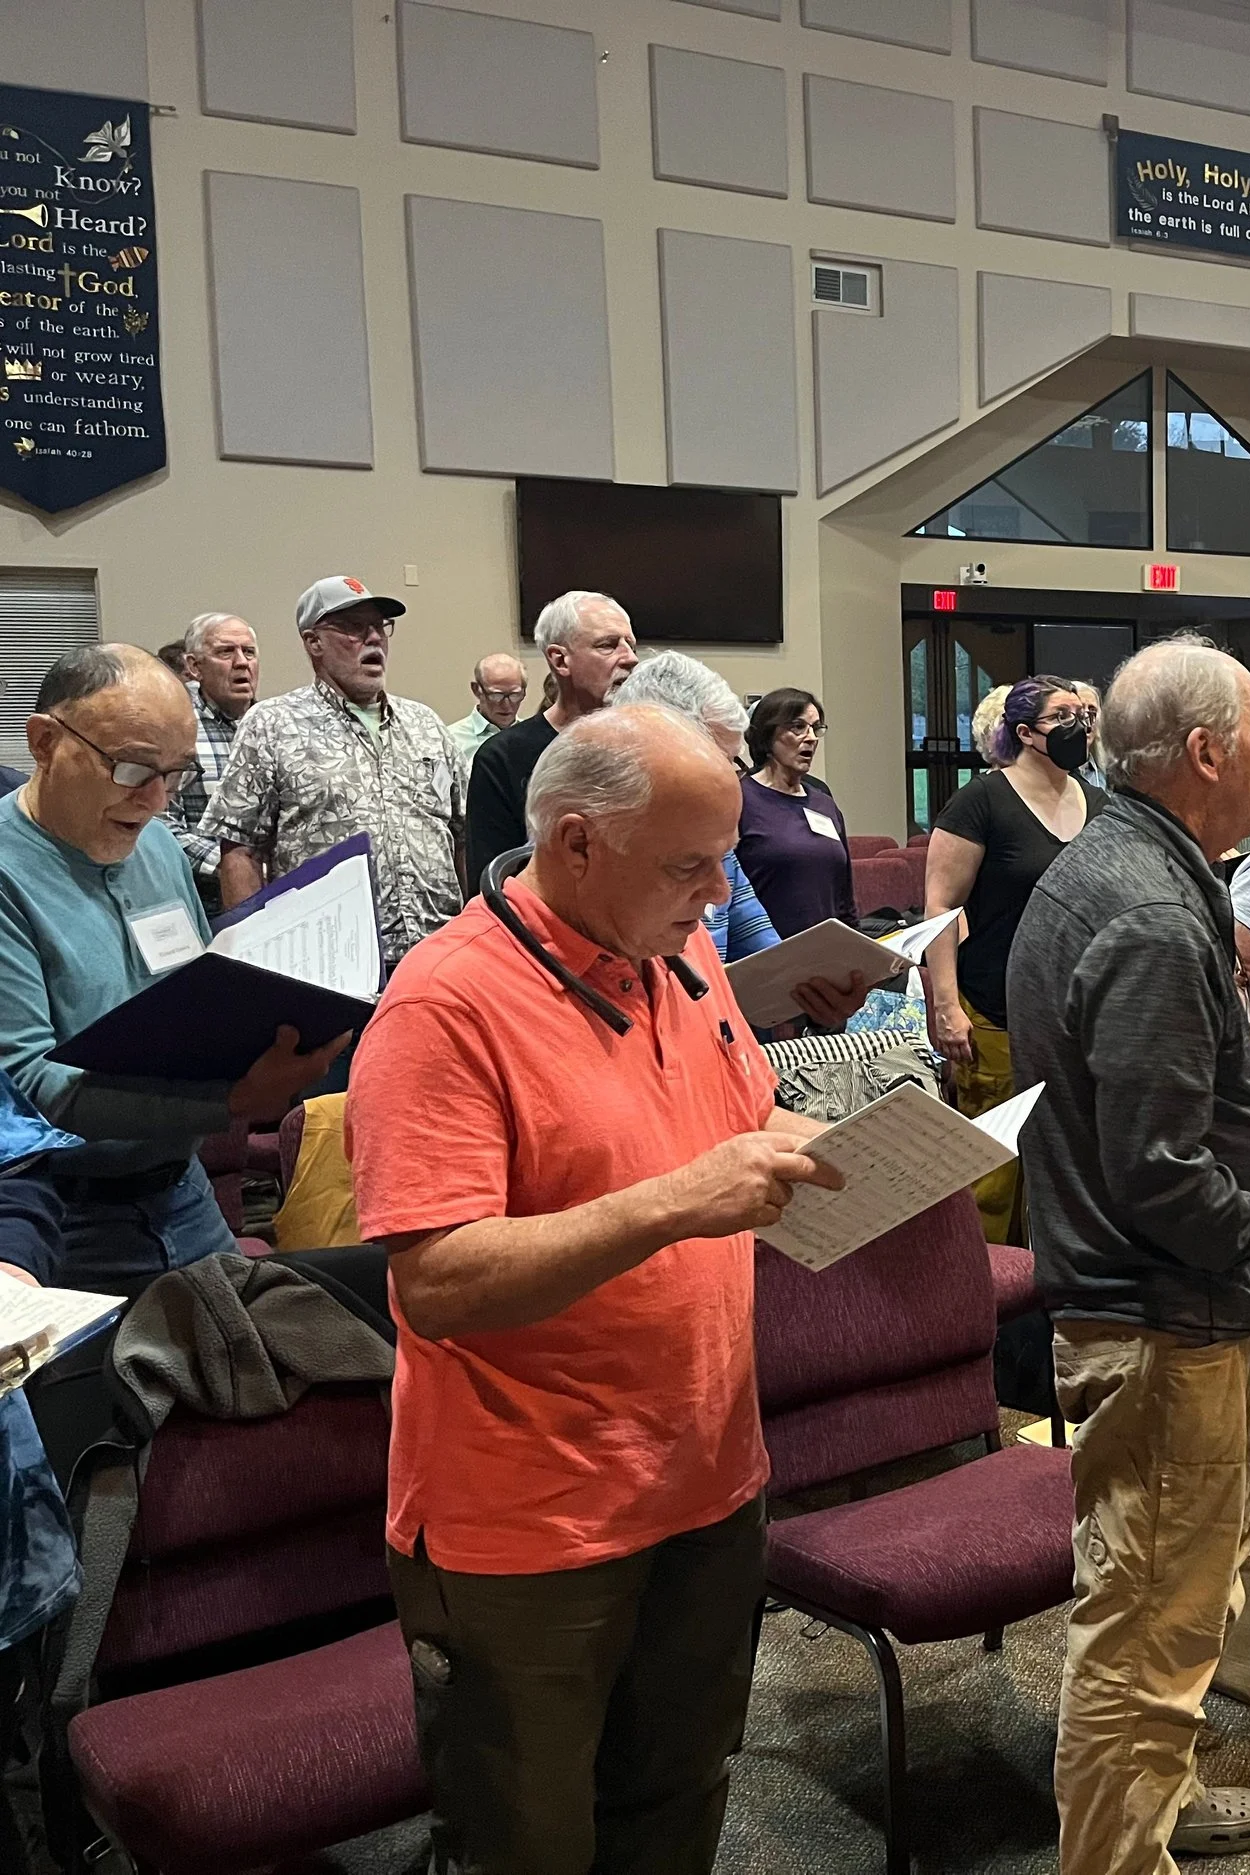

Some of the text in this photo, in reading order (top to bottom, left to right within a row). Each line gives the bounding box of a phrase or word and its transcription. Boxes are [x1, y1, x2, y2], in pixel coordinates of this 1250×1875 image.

[16, 152, 41, 164] not
[54, 165, 142, 196] Know?
[1136, 158, 1191, 189] Holy,
[0, 186, 62, 200] you not
[1162, 188, 1173, 202] is
[1178, 191, 1199, 206] the
[1203, 194, 1234, 213] Lord
[54, 207, 147, 236] Heard?
[1128, 208, 1151, 223] the
[1159, 215, 1197, 231] earth
[1201, 219, 1212, 235] is
[1219, 223, 1240, 239] full
[62, 242, 76, 255] is
[82, 244, 107, 258] the
[1, 260, 139, 298] lasting God,
[69, 301, 85, 314] of
[96, 304, 119, 317] the
[16, 317, 30, 330] of
[40, 319, 64, 334] the
[73, 325, 120, 338] earth.
[6, 343, 155, 367] will not grow tired
[51, 371, 145, 391] or weary,
[24, 392, 144, 413] understanding
[4, 418, 150, 438] one can fathom.
[1151, 565, 1176, 589] EXIT
[933, 590, 957, 610] EXIT
